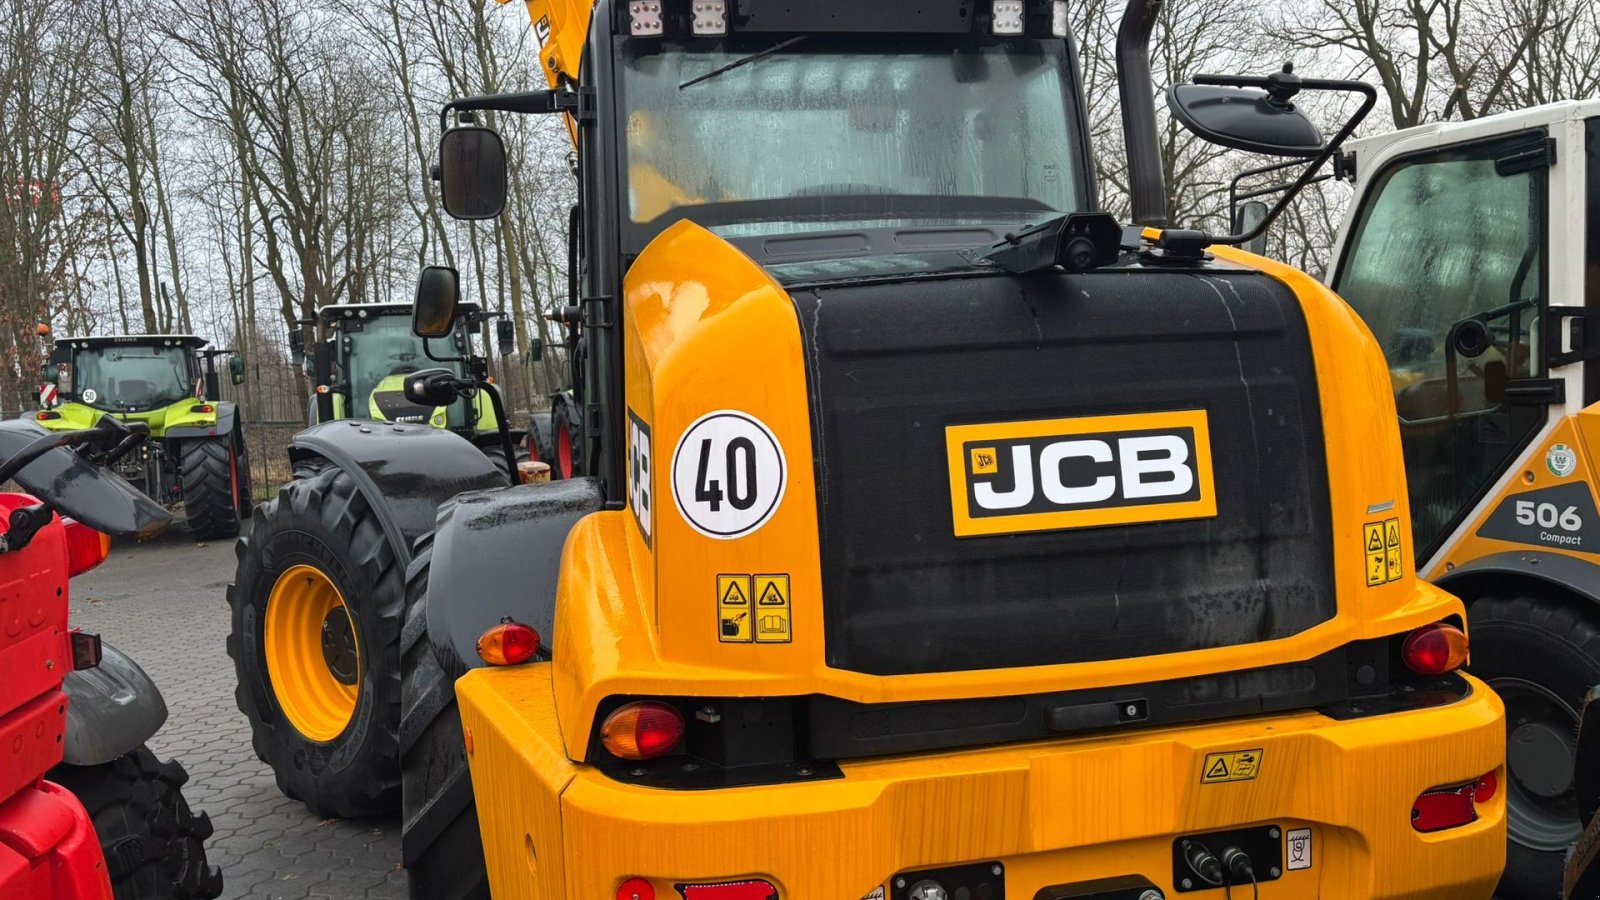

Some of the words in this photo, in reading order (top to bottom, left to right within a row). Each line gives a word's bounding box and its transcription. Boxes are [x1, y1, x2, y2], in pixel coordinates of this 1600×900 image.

[85, 391, 95, 400] 50
[695, 436, 758, 512] 40
[973, 435, 1193, 509] JCB
[978, 454, 993, 467] JCB
[629, 418, 651, 536] CB
[1516, 500, 1582, 531] 506
[1540, 531, 1581, 545] Compact
